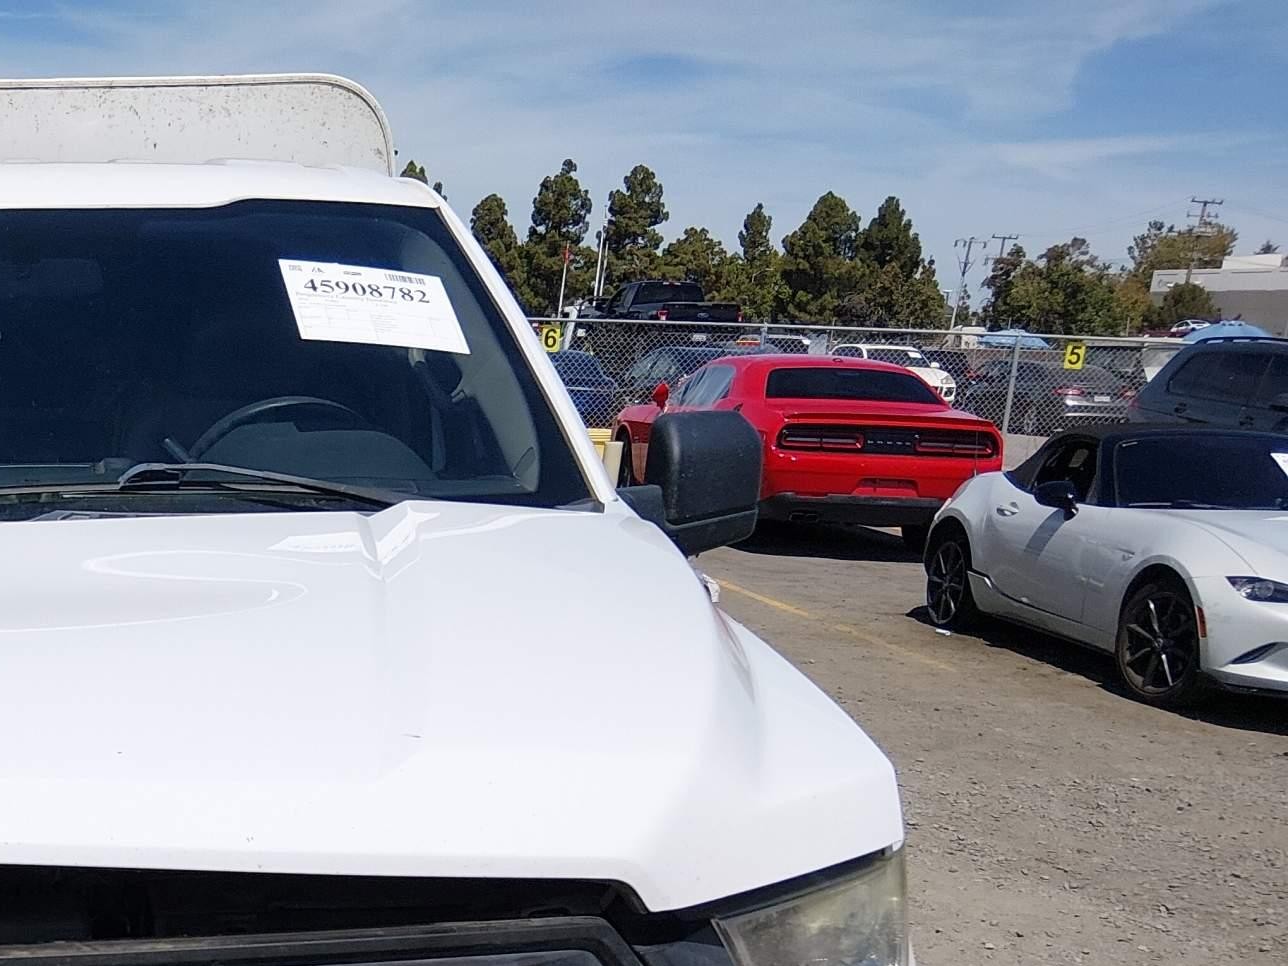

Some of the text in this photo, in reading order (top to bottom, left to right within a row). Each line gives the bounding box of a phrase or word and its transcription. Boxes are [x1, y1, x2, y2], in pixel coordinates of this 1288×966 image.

[303, 277, 431, 304] 45908782
[544, 328, 558, 348] 6
[1067, 346, 1082, 365] 5
